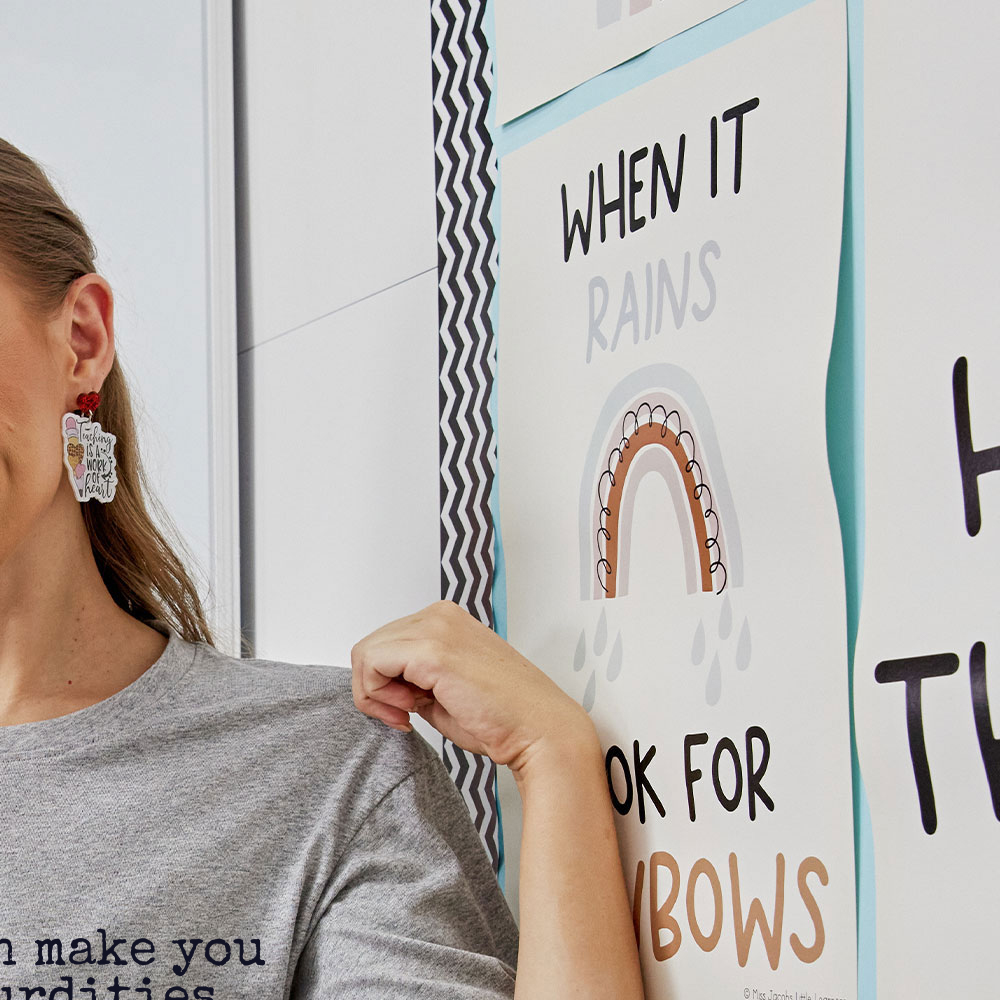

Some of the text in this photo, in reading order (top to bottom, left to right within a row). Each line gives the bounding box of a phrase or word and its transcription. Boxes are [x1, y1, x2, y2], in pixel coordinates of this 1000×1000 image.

[561, 97, 760, 263] WHEN IT
[585, 239, 722, 364] RAINS
[76, 417, 113, 454] Teaching
[86, 459, 107, 472] WORK
[92, 473, 100, 484] OF
[85, 474, 114, 498] heart
[684, 725, 775, 822] FOR
[35, 929, 156, 966] make
[172, 938, 266, 976] you
[752, 989, 766, 1000] Miss
